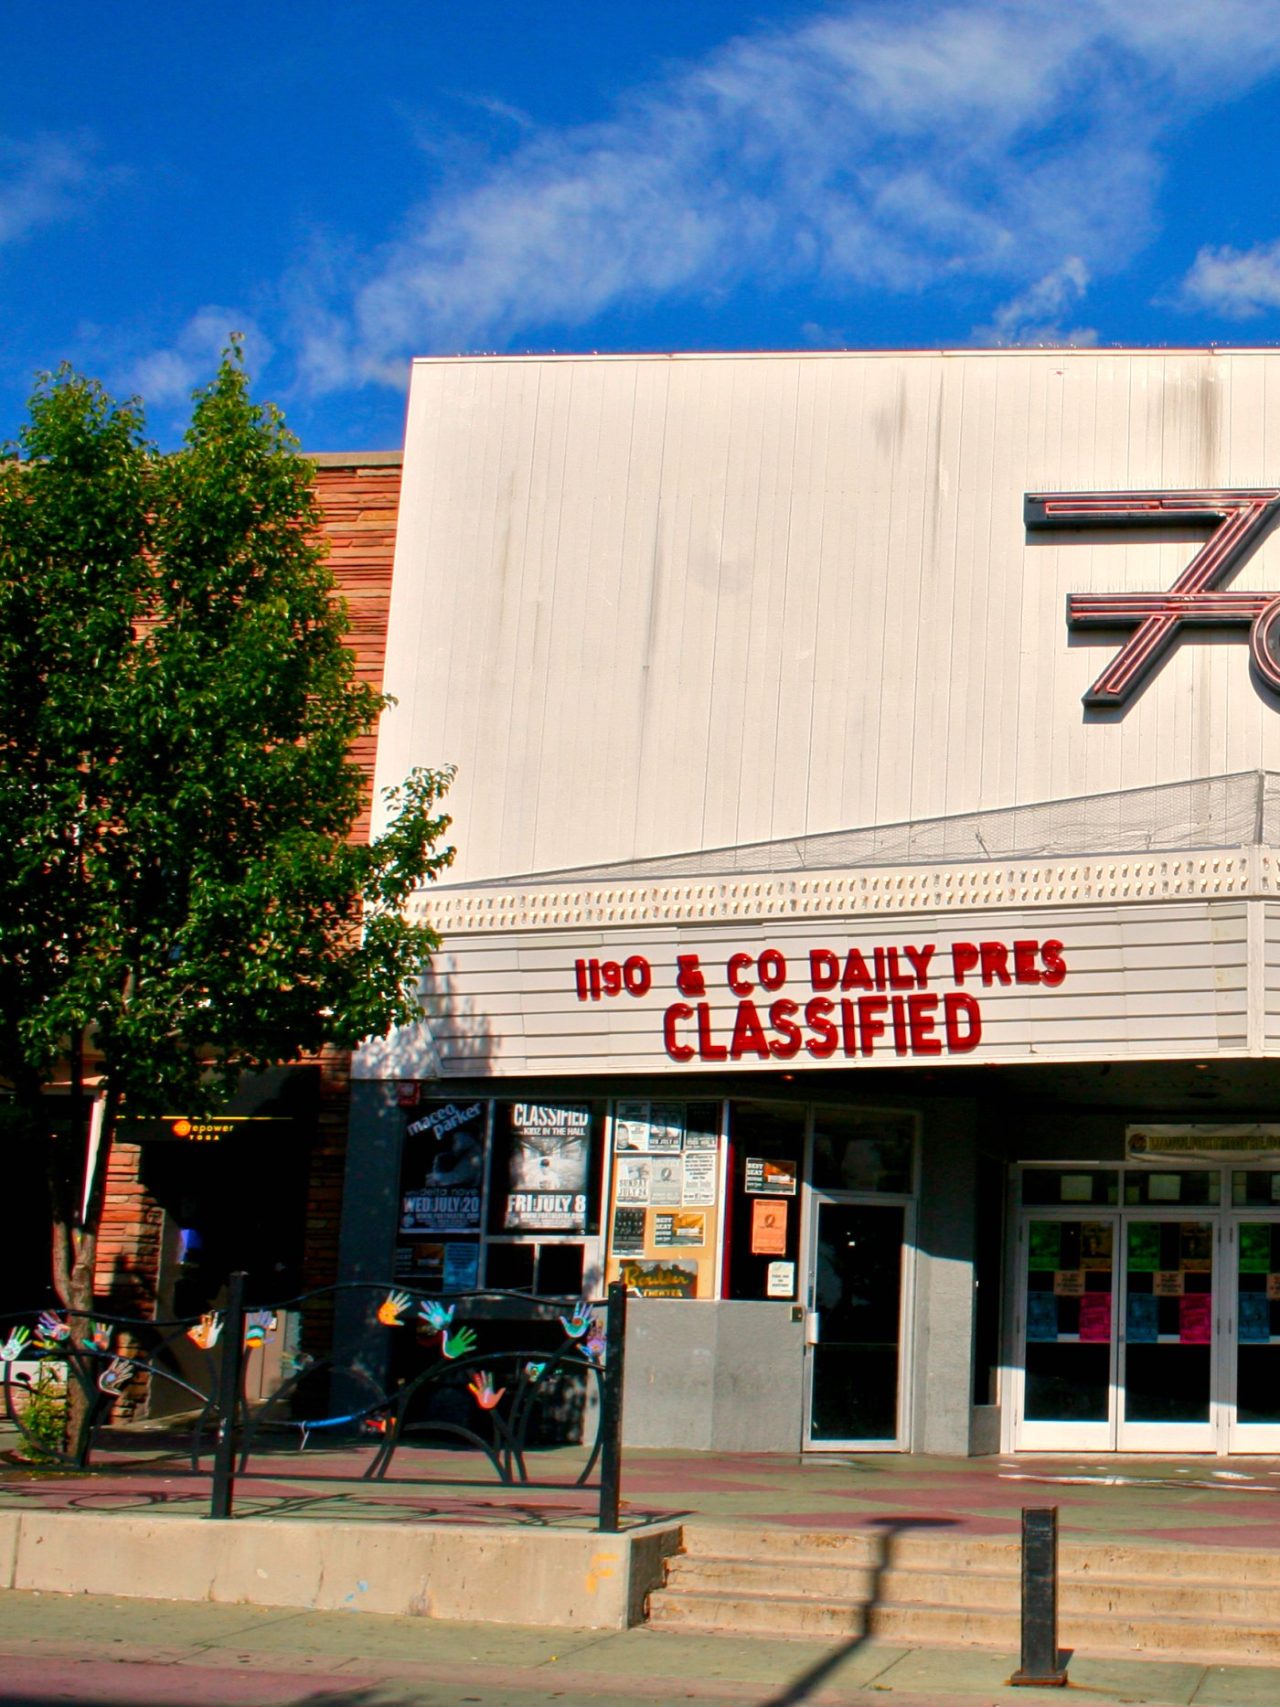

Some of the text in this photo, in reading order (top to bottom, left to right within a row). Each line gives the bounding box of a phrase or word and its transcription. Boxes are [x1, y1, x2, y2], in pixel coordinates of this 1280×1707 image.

[676, 954, 706, 997] &
[727, 948, 787, 997] CO
[809, 944, 936, 992] DAILY
[952, 939, 1067, 987] PRES
[664, 992, 982, 1063] CLASSIFIED
[407, 1104, 457, 1136] maceo
[432, 1103, 482, 1140] parker
[514, 1104, 588, 1126] CLASSIFIED
[523, 1127, 585, 1136] KIDZ IN THE HALL
[404, 1196, 480, 1213] WED JULY 20
[507, 1194, 586, 1213] FRI JULY 8
